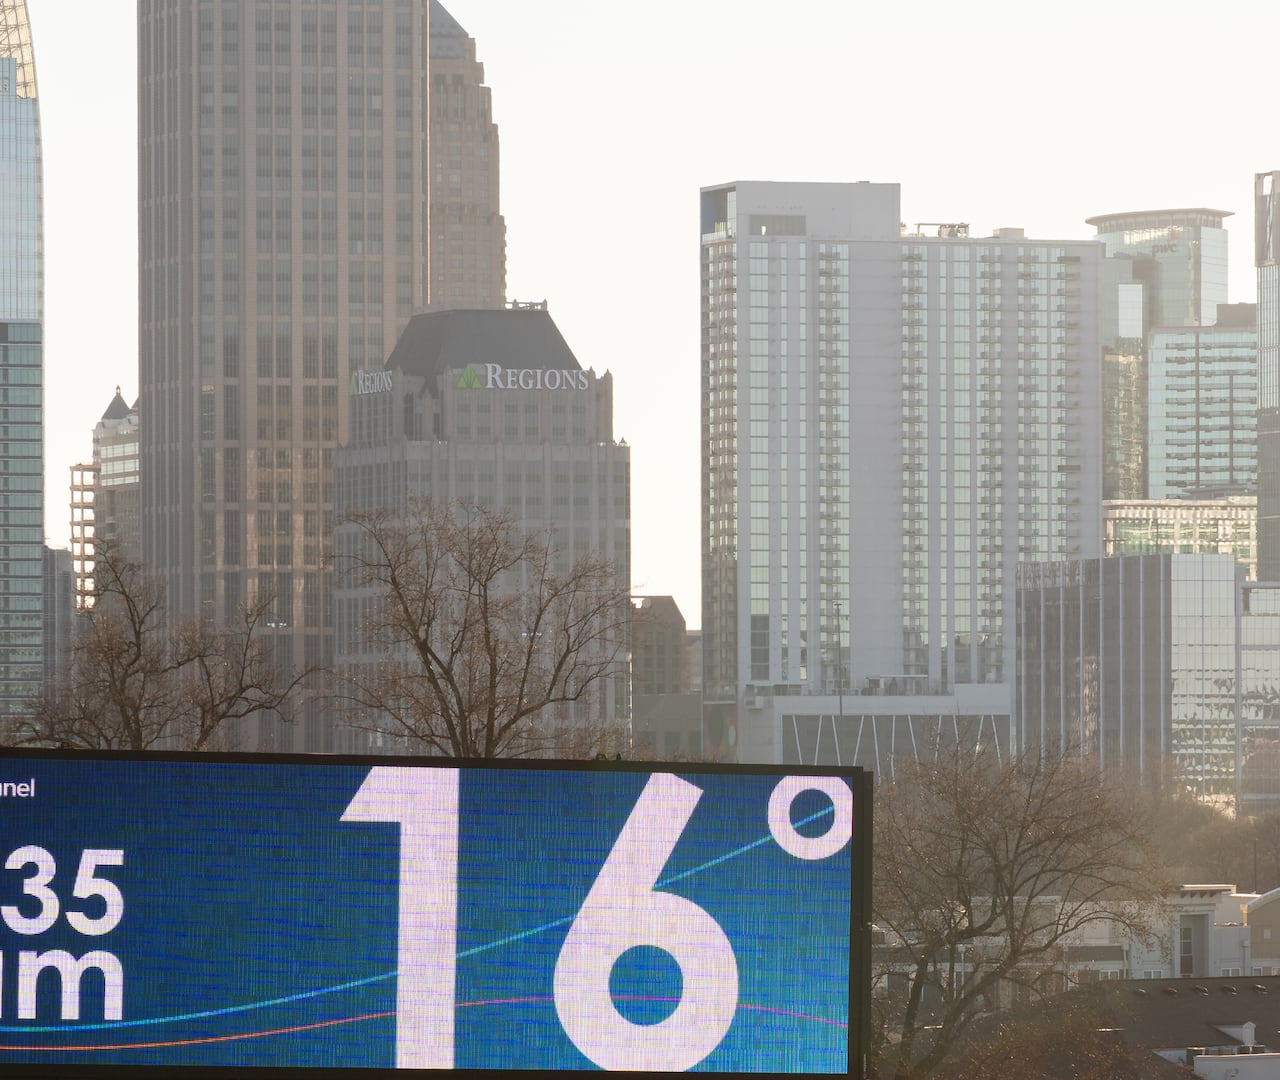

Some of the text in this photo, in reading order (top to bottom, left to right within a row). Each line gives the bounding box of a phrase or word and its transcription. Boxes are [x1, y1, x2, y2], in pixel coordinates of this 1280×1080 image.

[1152, 244, 1177, 257] pwc
[358, 370, 393, 394] REGIONS
[485, 363, 589, 390] REGIONS
